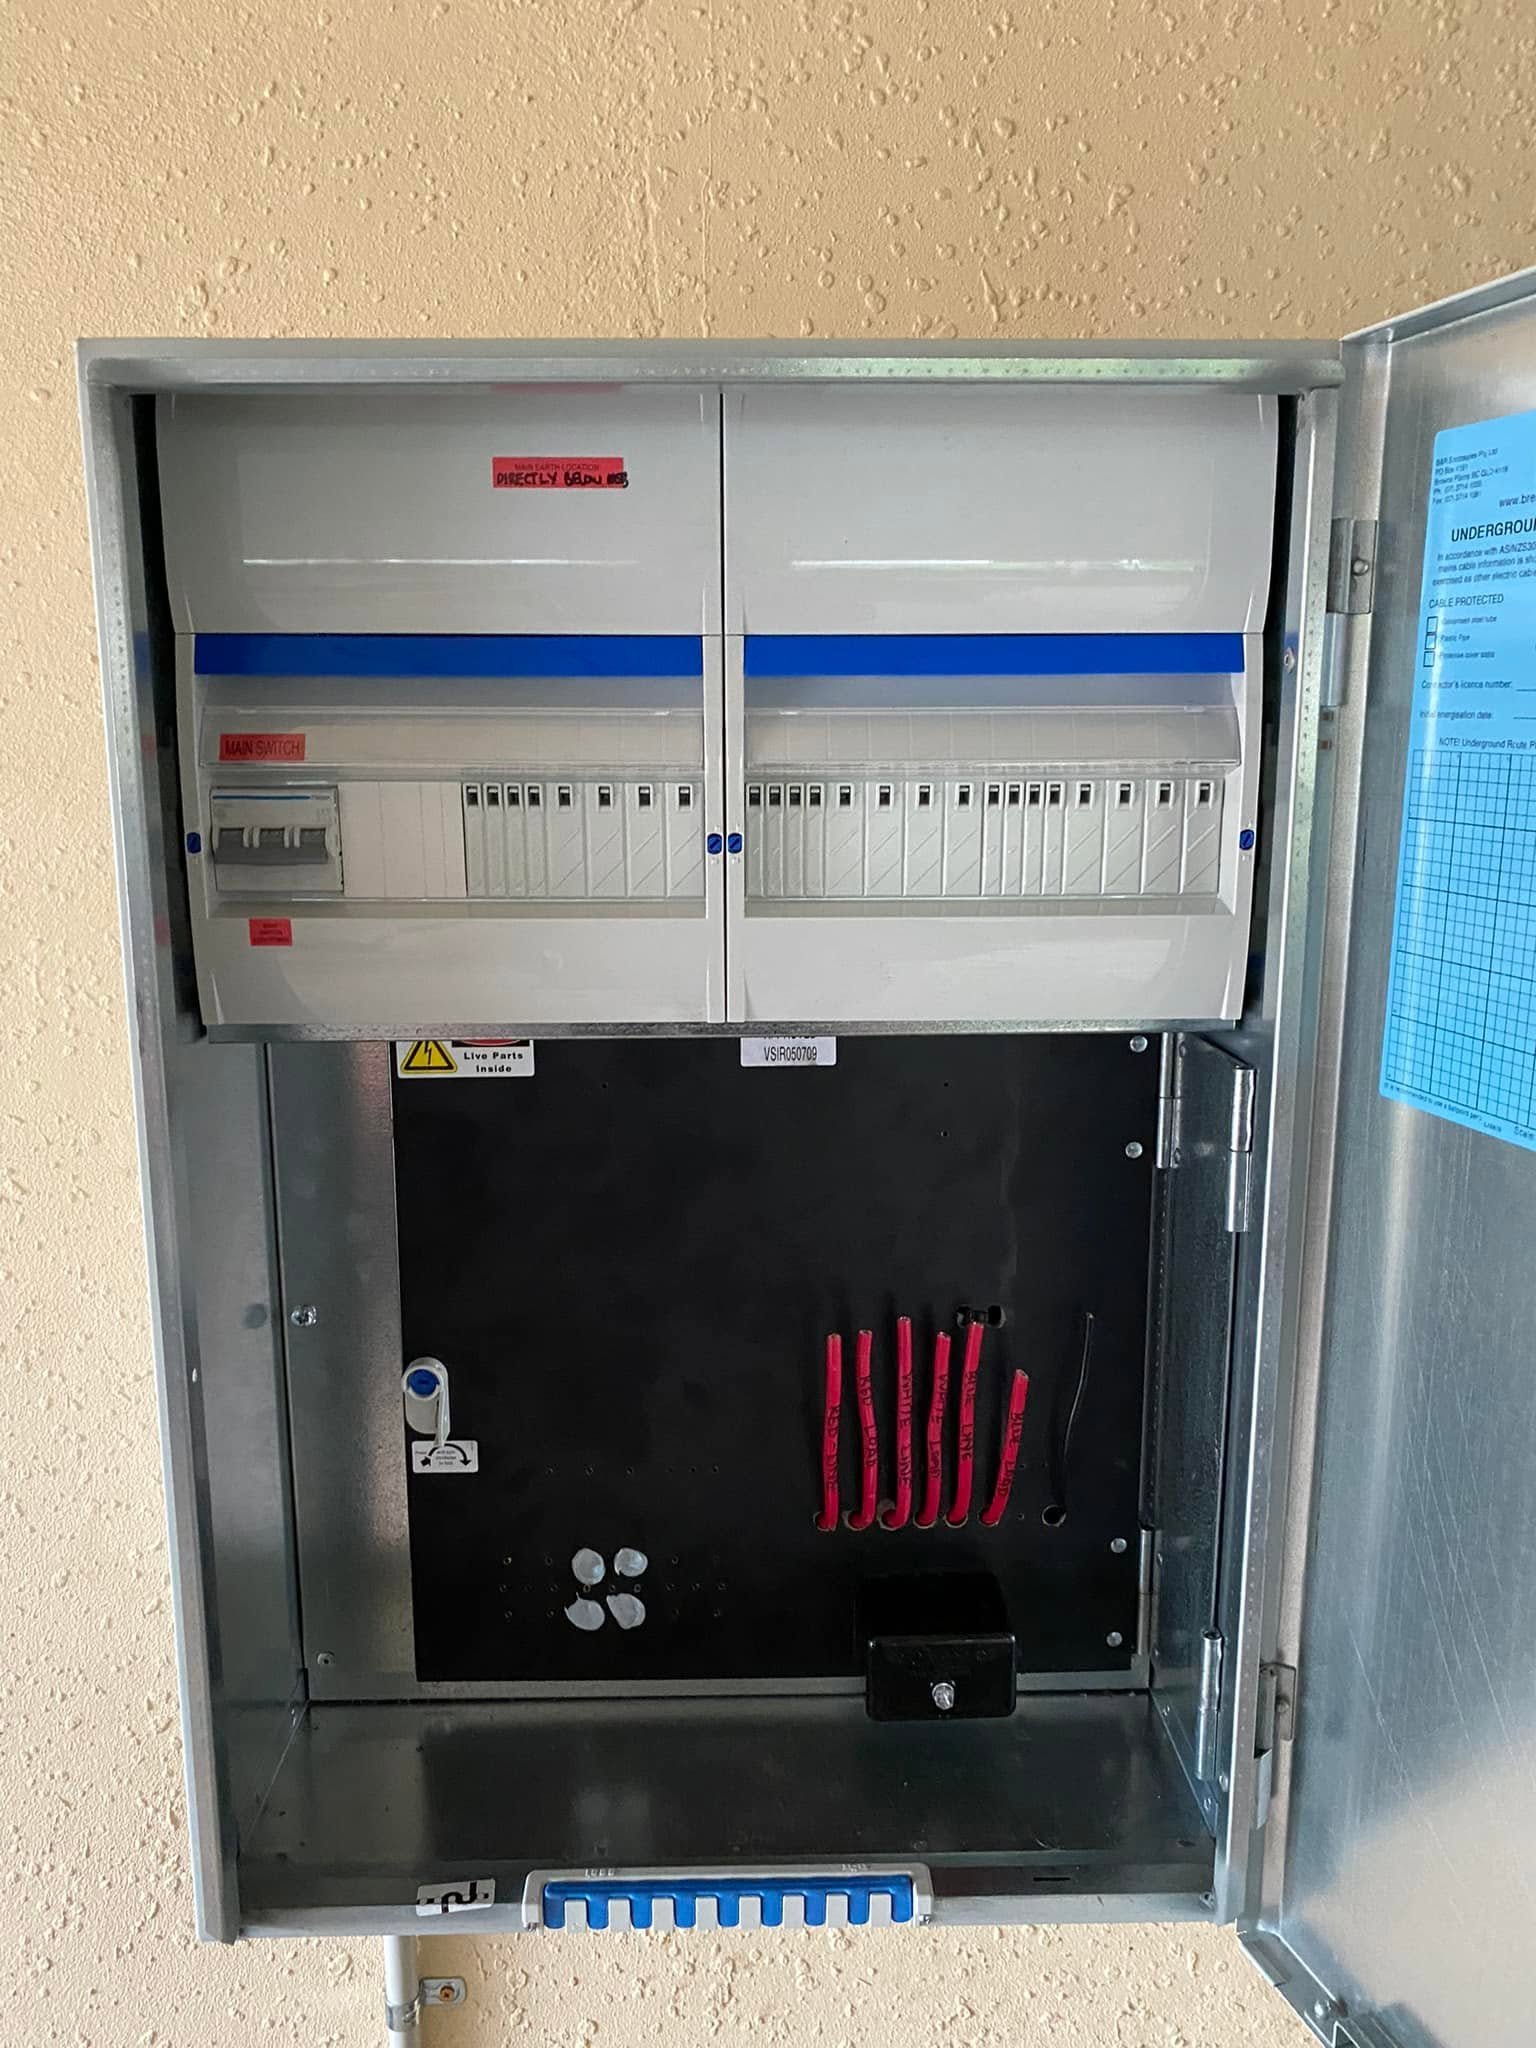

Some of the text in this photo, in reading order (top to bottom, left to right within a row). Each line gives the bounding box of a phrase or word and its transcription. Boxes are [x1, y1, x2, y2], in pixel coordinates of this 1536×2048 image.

[496, 472, 557, 486] DIRECTLY
[1451, 518, 1536, 542] UNDERGROU
[1478, 558, 1515, 568] information
[1429, 593, 1504, 608] CABLE PROTECTED
[225, 740, 300, 756] MAIN SWITCH
[1462, 739, 1506, 749] Underground
[1507, 740, 1527, 749] Route
[464, 1052, 523, 1060] Live Parts
[764, 1046, 817, 1061] VSIR050709
[476, 1065, 512, 1073] Inside
[859, 1376, 876, 1467] RED LOAD
[900, 1371, 911, 1485] WHITE LINE
[960, 1424, 974, 1461] LINE
[997, 1412, 1024, 1496] BLUE LOAD
